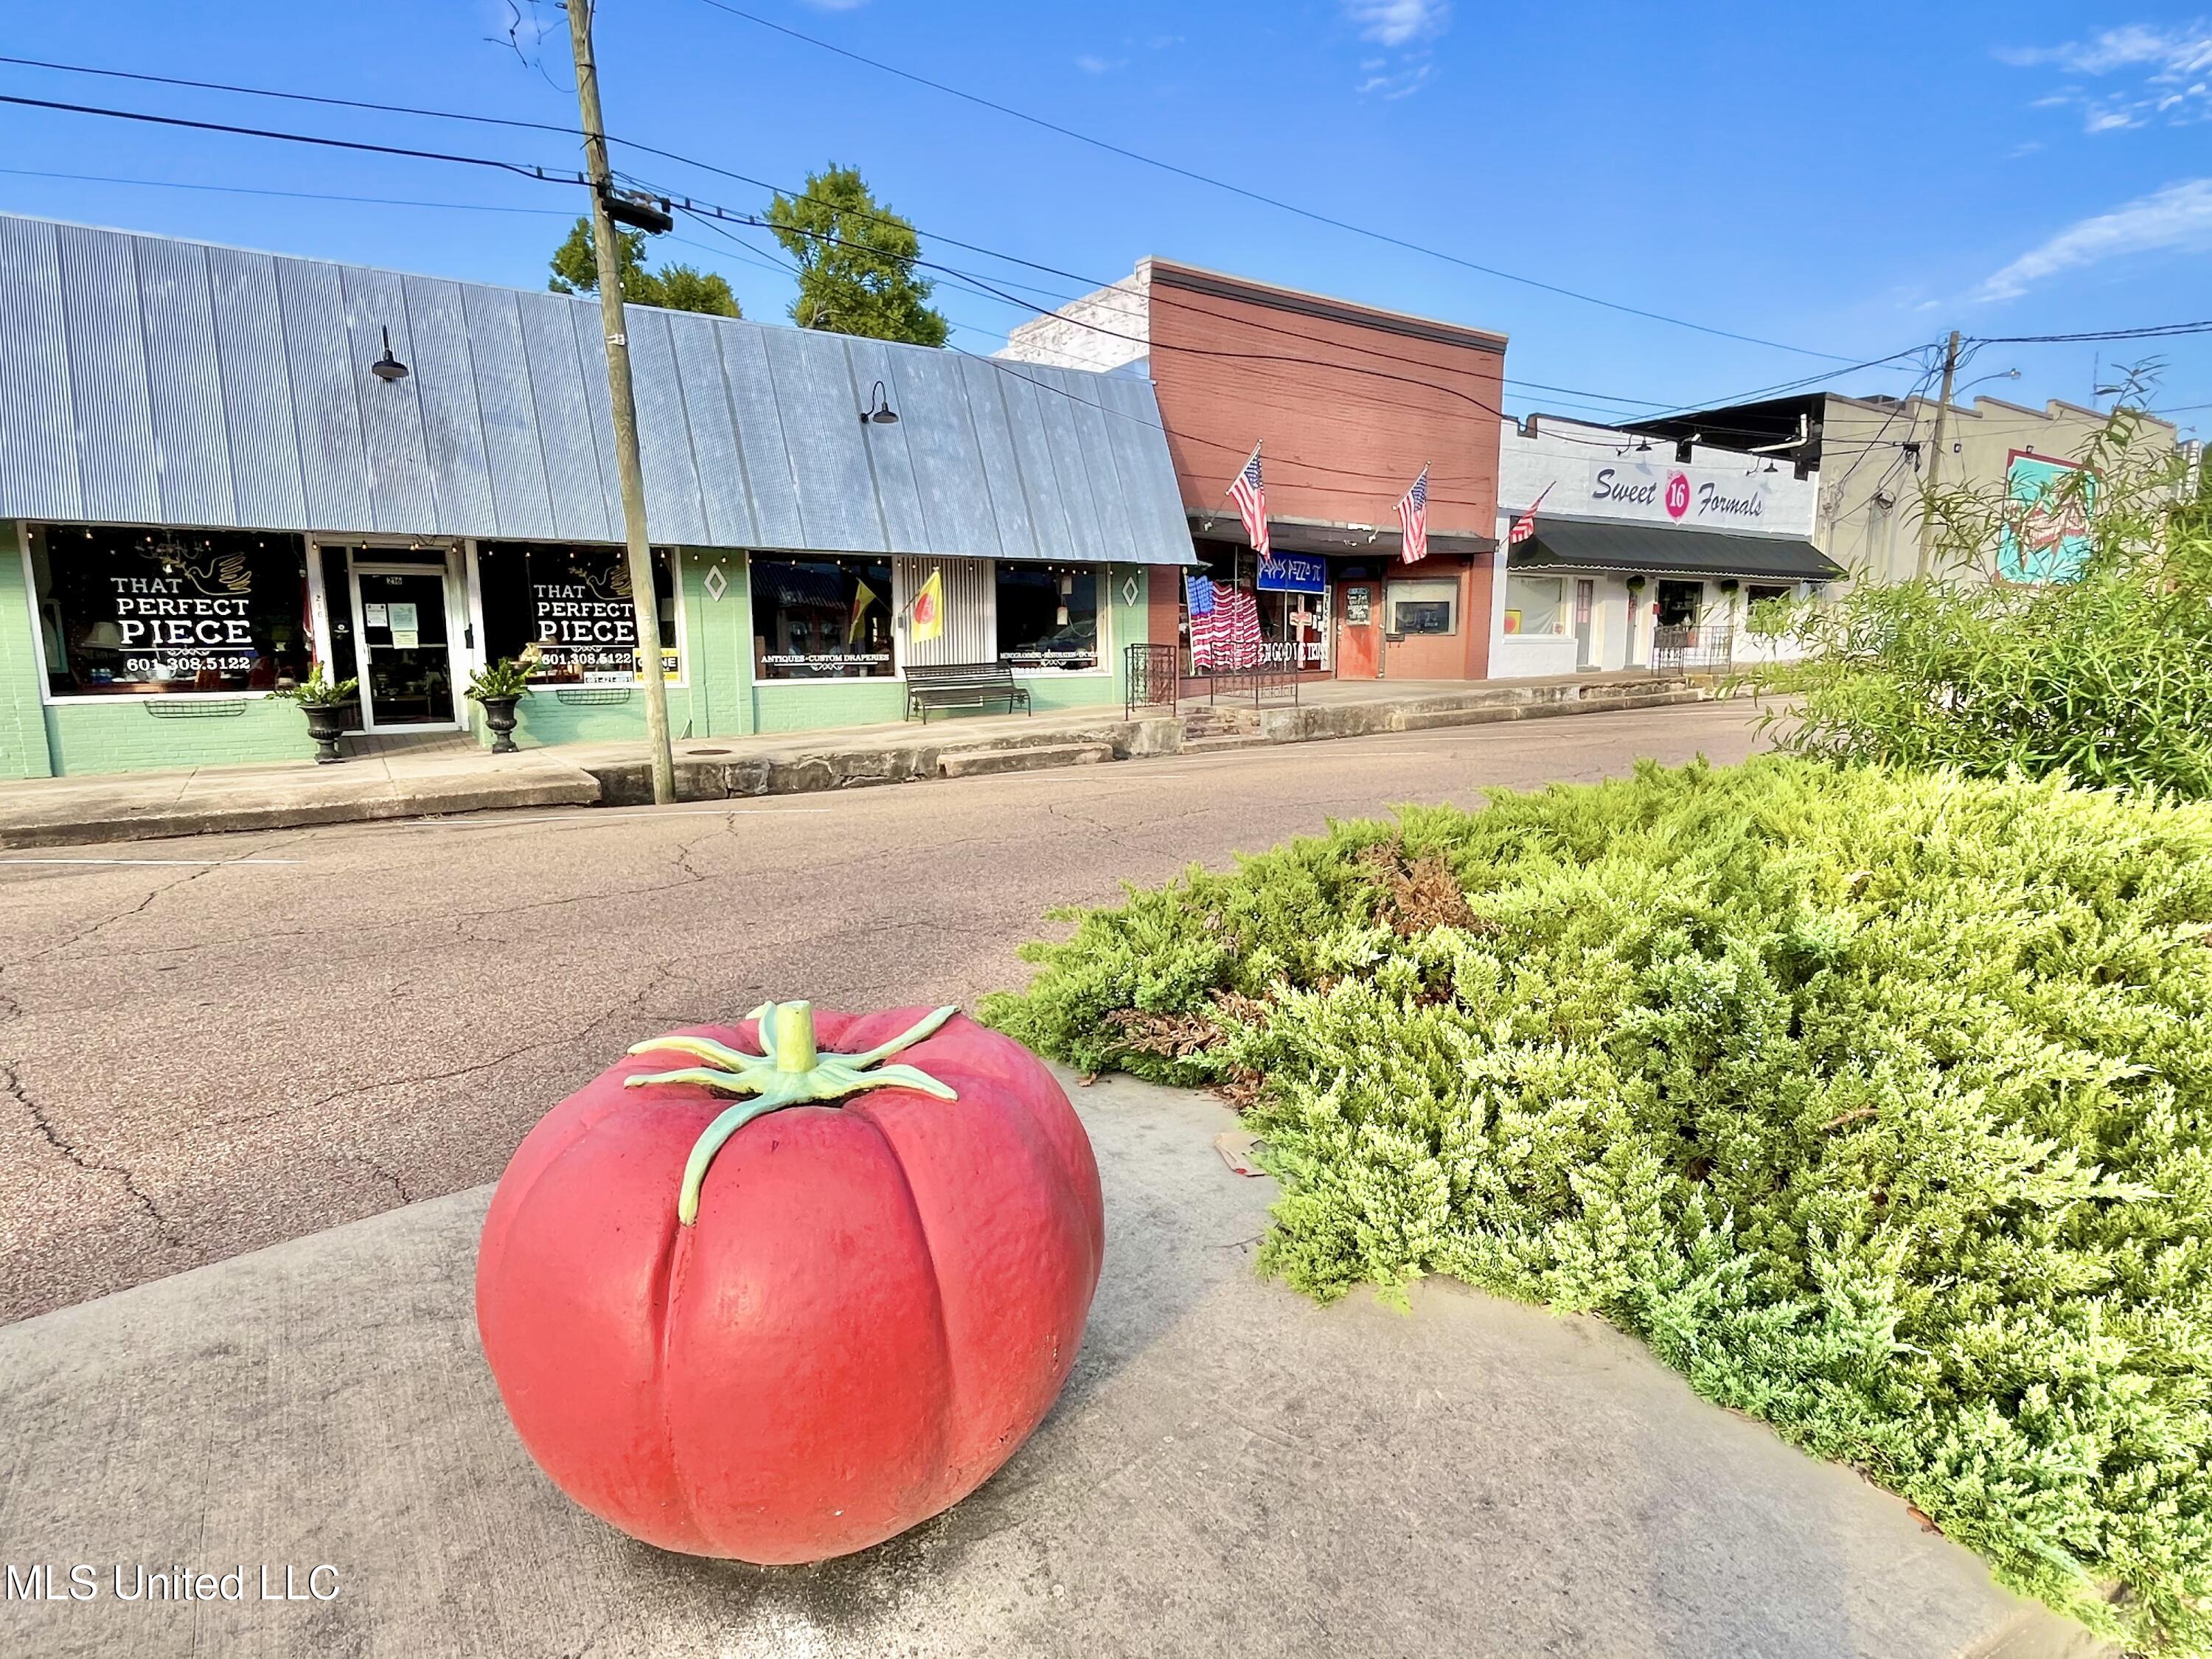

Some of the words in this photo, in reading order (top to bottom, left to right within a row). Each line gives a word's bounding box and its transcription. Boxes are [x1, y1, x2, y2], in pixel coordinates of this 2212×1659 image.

[1593, 468, 1658, 506] Sweet
[1669, 483, 1686, 507] 16
[1698, 482, 1763, 517] Formals
[111, 578, 183, 594] THAT
[534, 585, 586, 598] THAT
[116, 598, 249, 615] PERFECT
[537, 602, 633, 617] PERFECT
[118, 620, 252, 644] PIECE
[538, 620, 635, 641] PIECE
[126, 657, 251, 672] 601308.5122
[542, 653, 632, 665] 601.308.5122
[760, 655, 805, 663] ANTIQUES
[808, 654, 843, 662] CUSTOM
